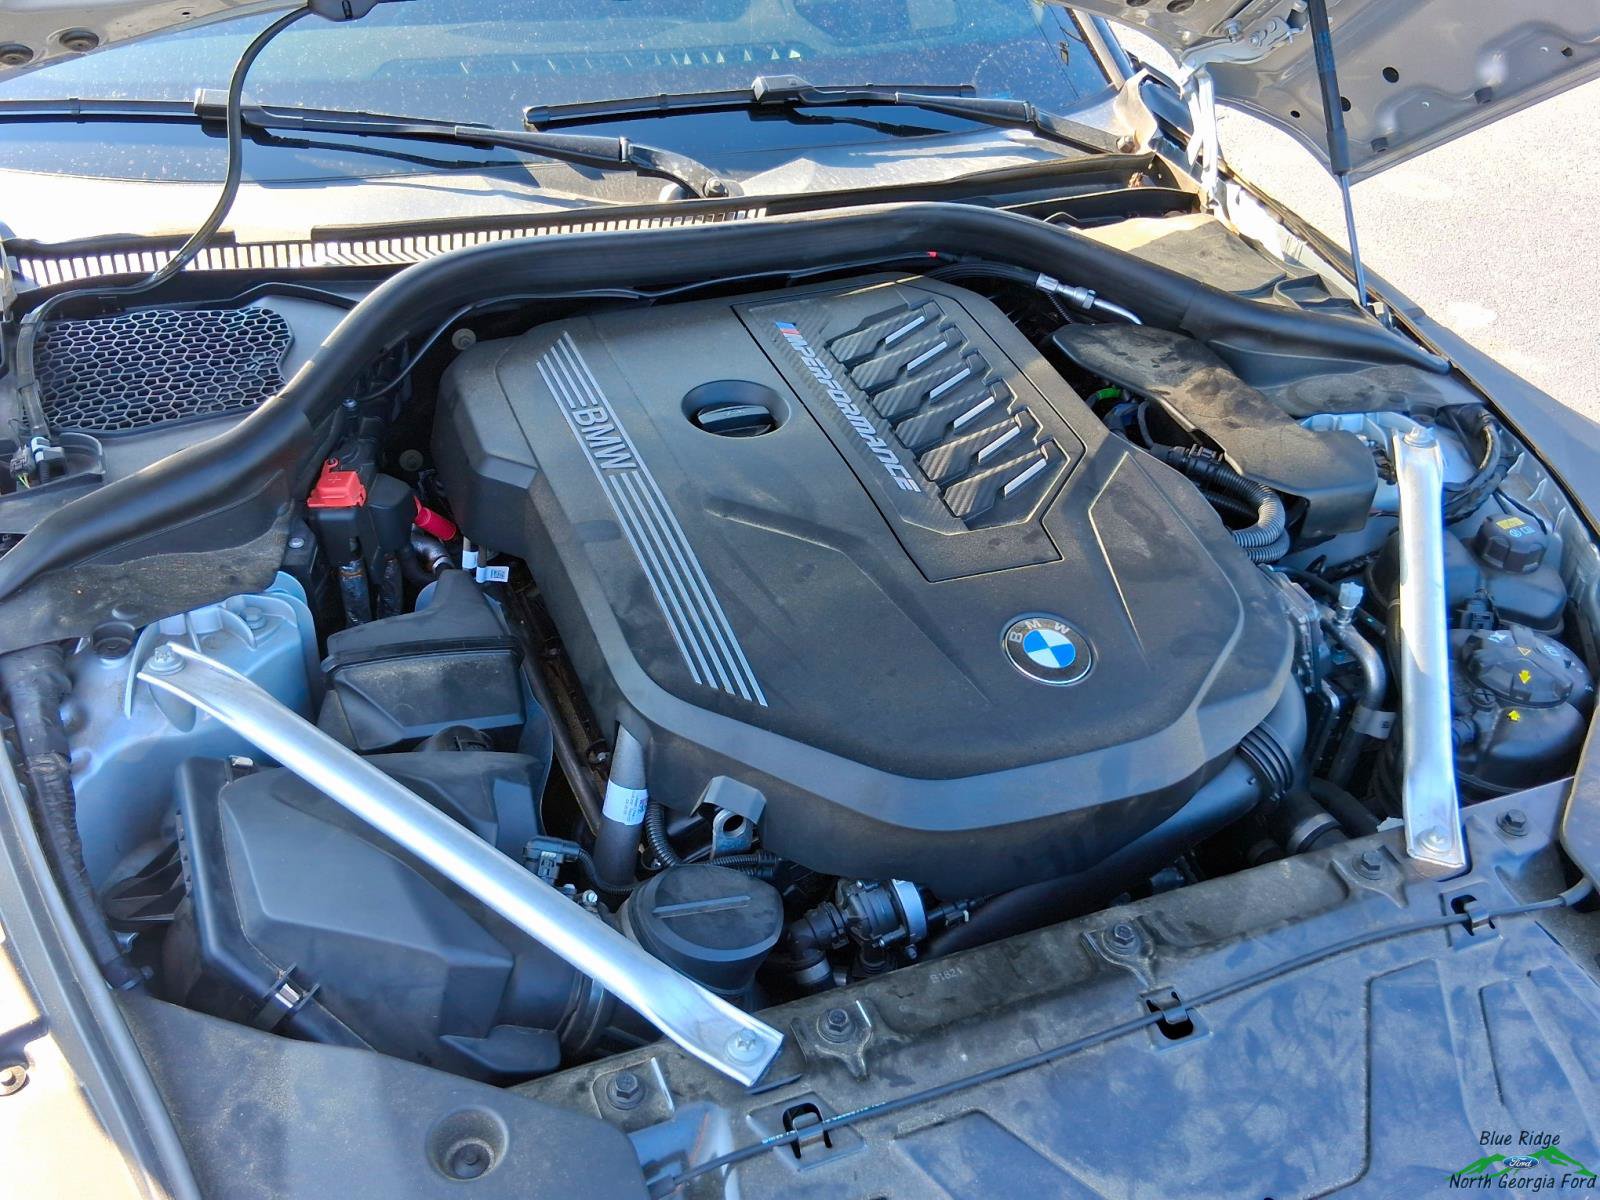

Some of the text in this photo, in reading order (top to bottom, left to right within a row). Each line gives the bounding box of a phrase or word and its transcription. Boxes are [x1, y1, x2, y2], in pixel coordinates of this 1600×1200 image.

[571, 406, 638, 469] BMW
[792, 345, 922, 493] PERFORMANCE
[1008, 618, 1071, 644] BMW
